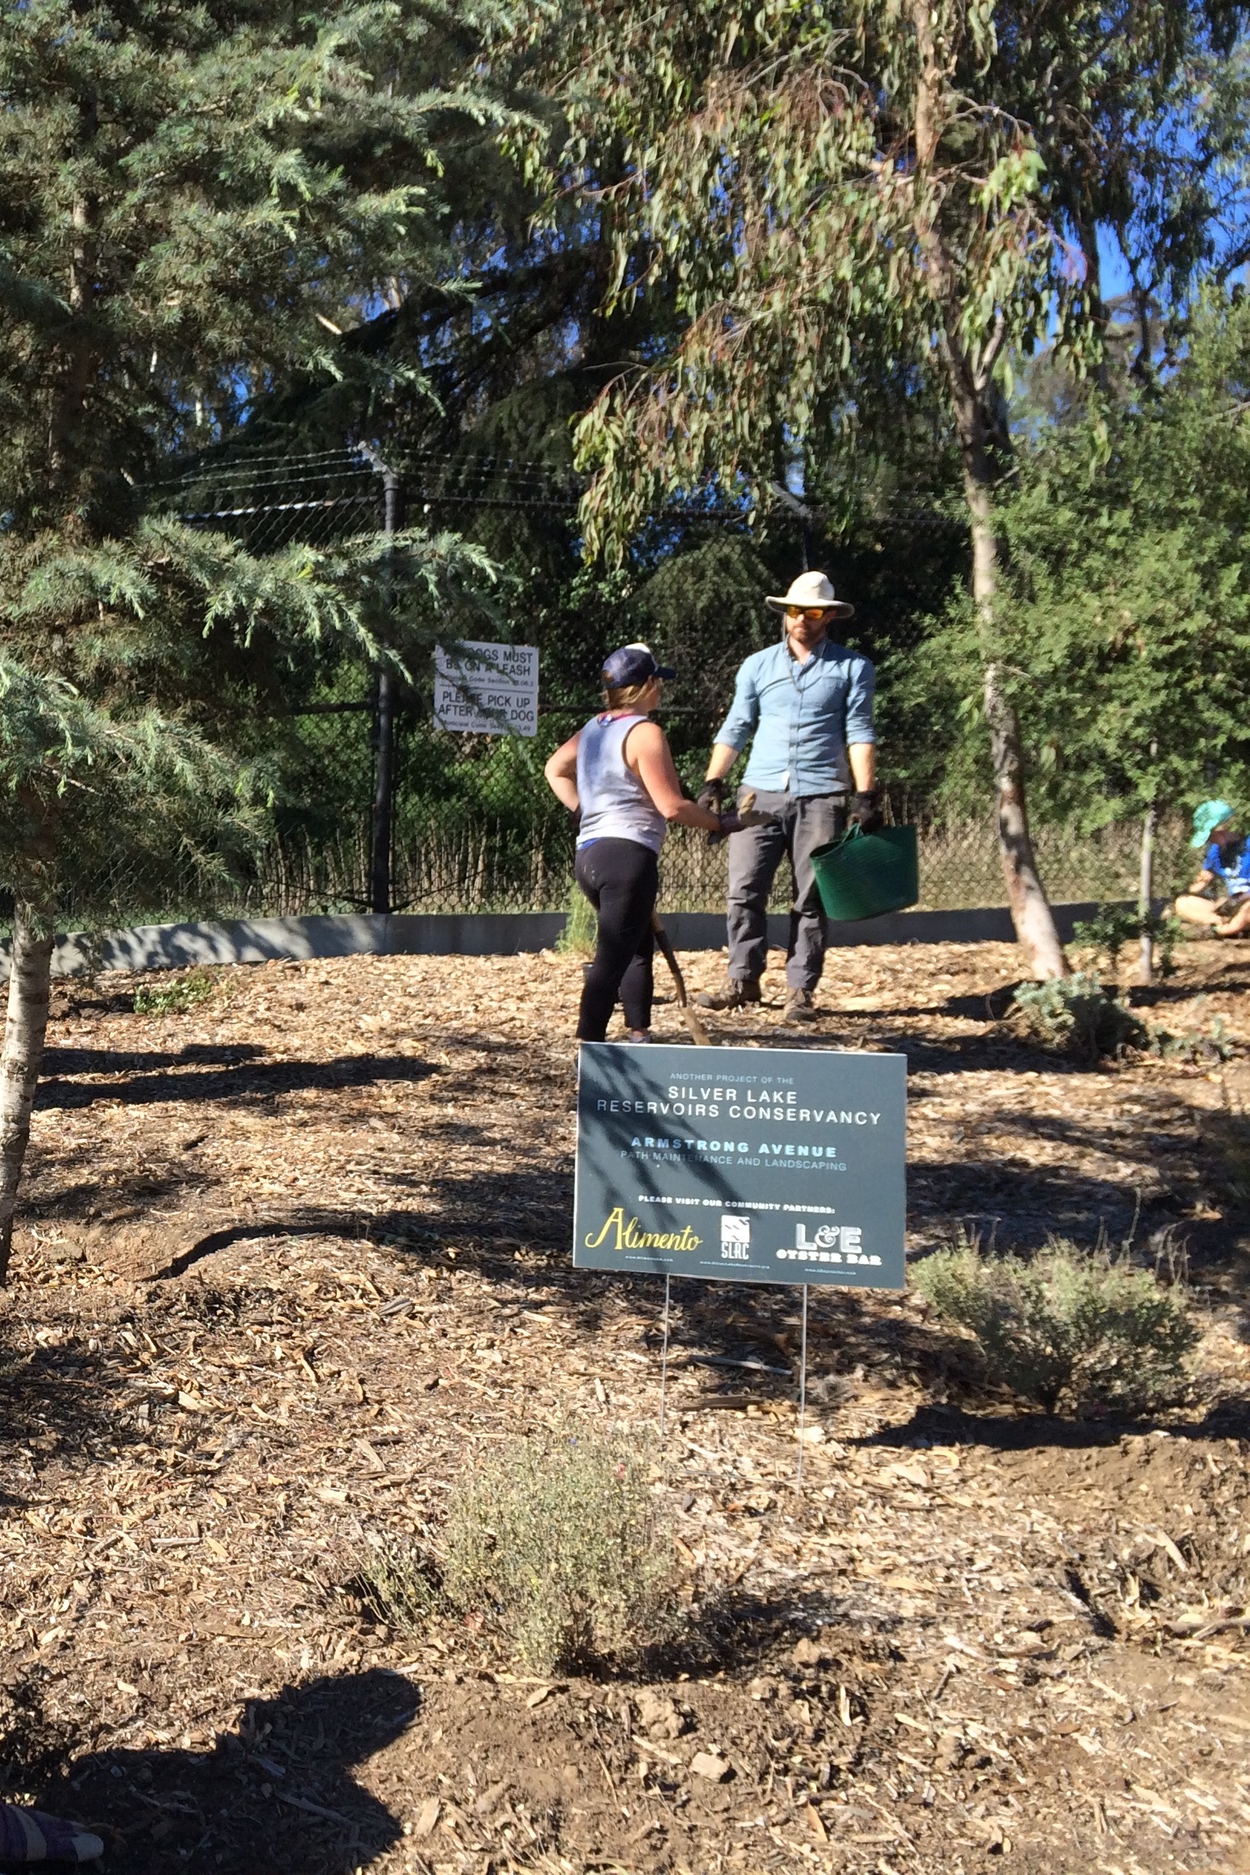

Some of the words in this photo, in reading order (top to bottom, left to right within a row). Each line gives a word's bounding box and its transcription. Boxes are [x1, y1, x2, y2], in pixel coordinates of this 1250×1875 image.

[503, 651, 533, 663] MUST
[497, 663, 531, 676] LEASH
[443, 691, 482, 704] PLEE
[488, 695, 511, 708] PICK
[516, 697, 530, 708] UP
[438, 704, 472, 717] AFTER
[511, 709, 534, 722] DOG
[669, 1072, 713, 1082] ANOTHER
[716, 1074, 758, 1083] PROJECT
[761, 1076, 773, 1084] OF
[777, 1077, 795, 1085] THE
[668, 1086, 737, 1101] SILVER
[747, 1089, 797, 1104] LAKE
[597, 1099, 719, 1118] RESERVOIRS
[729, 1105, 881, 1125] CONSERVANCY
[631, 1136, 749, 1153] ARMSTRONG
[758, 1142, 837, 1158] AVENUE
[620, 1150, 649, 1159] PATH
[653, 1151, 733, 1165] MAINTENANCE
[737, 1157, 760, 1166] AND
[765, 1158, 847, 1171] LANDSCAPING
[638, 1194, 673, 1204] PLEASE
[675, 1197, 700, 1206] VISIT
[702, 1199, 722, 1207] OUR
[725, 1200, 781, 1211] COMMUNITY
[783, 1203, 836, 1214] PARTNERS:
[584, 1207, 704, 1251] Alimento
[795, 1222, 862, 1254] L&E
[776, 1248, 842, 1263] OYSTER
[846, 1254, 882, 1266] BAR
